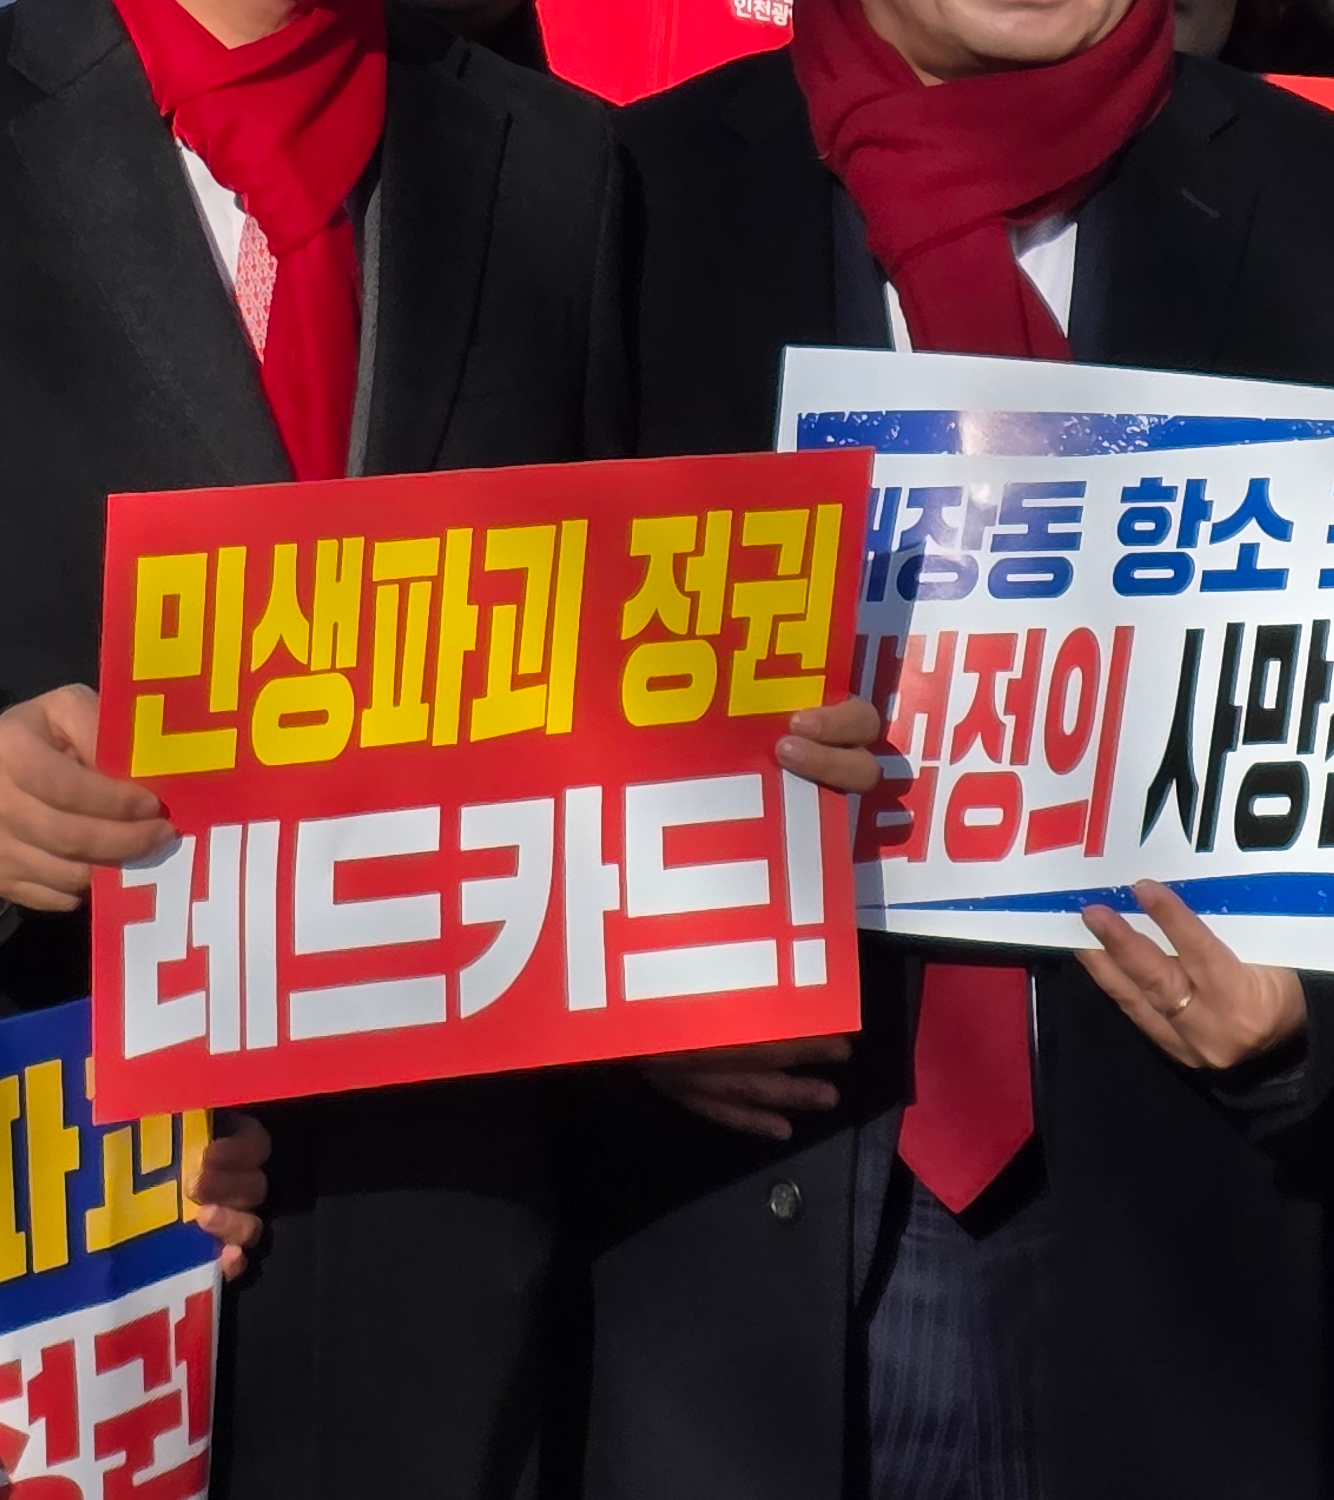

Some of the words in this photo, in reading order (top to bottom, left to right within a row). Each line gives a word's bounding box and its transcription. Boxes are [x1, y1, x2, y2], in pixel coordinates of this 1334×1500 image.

[131, 528, 589, 779] 민생파괴
[620, 503, 843, 727] 정권
[1112, 476, 1295, 597] 항소
[122, 768, 828, 1060] 레드카드!
